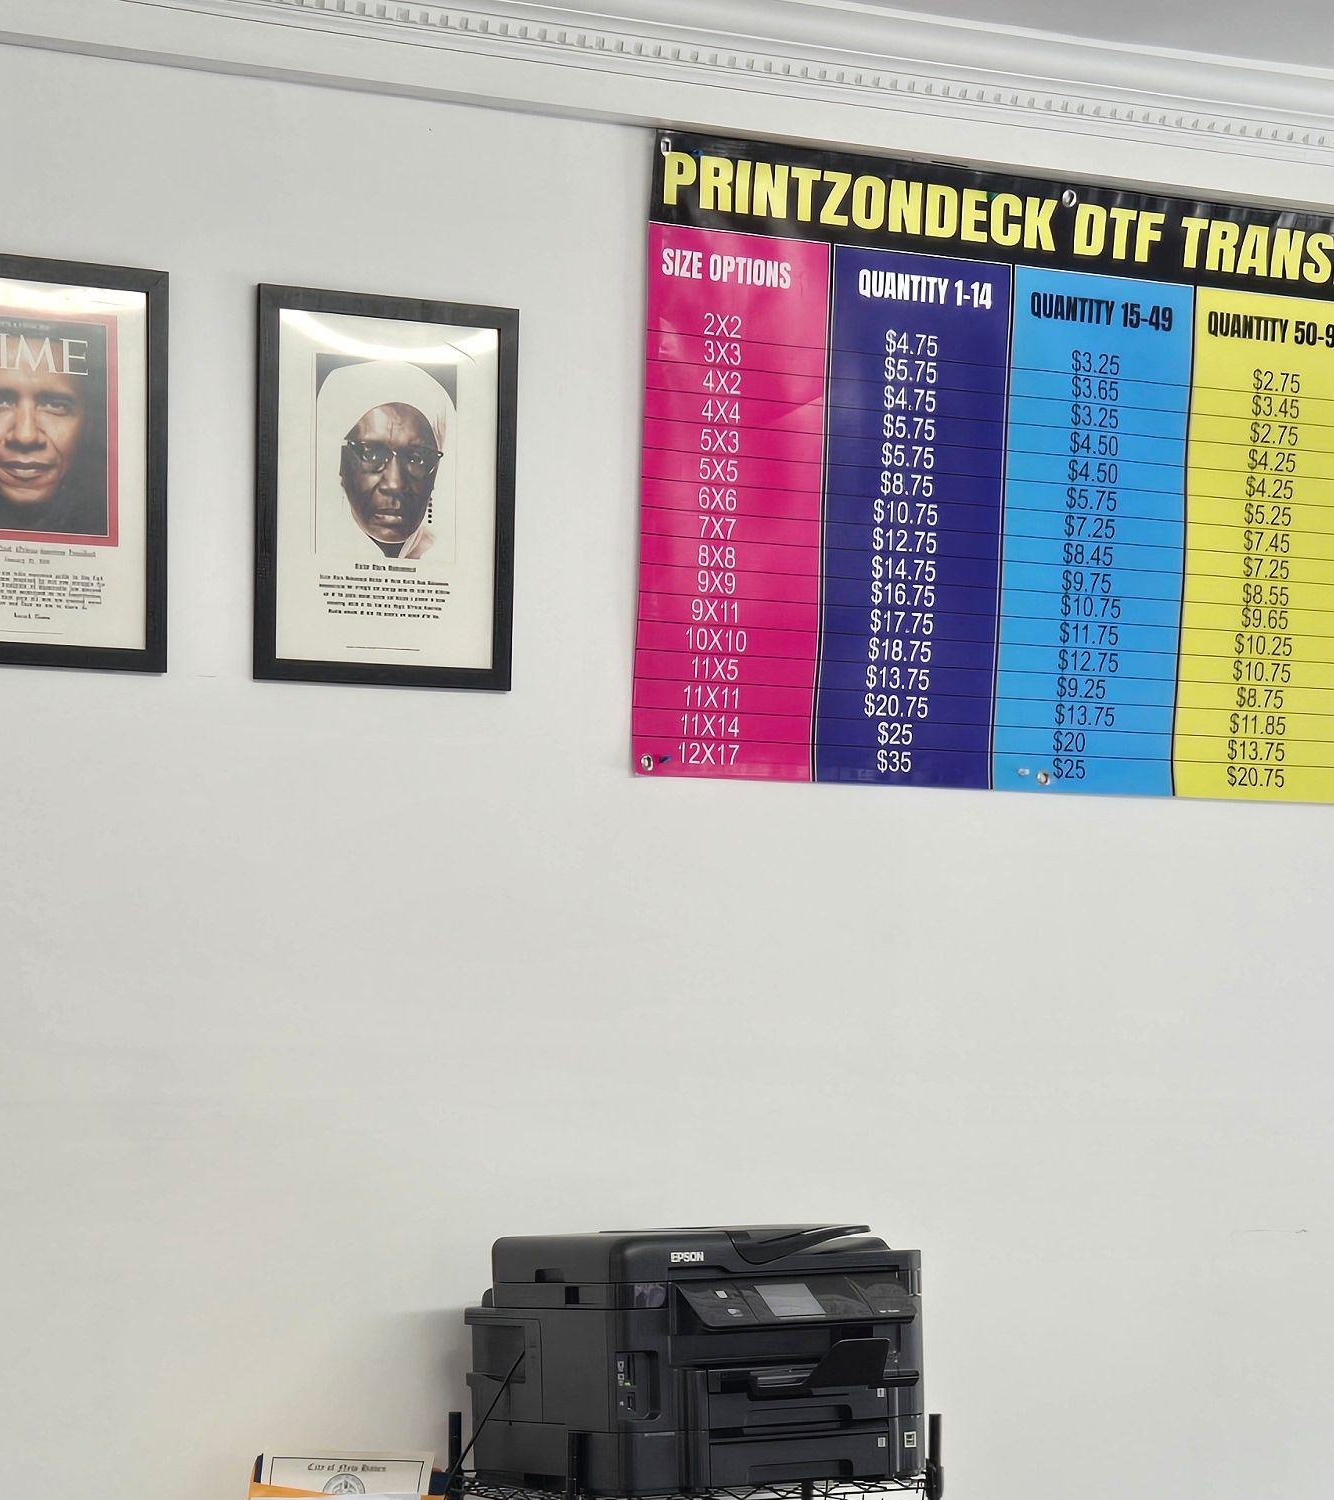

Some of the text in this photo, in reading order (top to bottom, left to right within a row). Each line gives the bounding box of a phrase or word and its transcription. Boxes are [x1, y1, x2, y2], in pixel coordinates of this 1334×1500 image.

[662, 151, 1057, 249] PRINTZONDECK
[1073, 205, 1165, 265] DTF
[661, 249, 792, 290] SIZE OPTIONS
[857, 270, 993, 310] QUANTITY 1-14
[1029, 292, 1173, 332] QUANTITY 15-49
[703, 312, 743, 339] 2X2
[1207, 312, 1289, 345] QUANTITY
[703, 341, 743, 366] 3X3
[885, 329, 939, 359] $4.75
[883, 358, 938, 386] $5.75
[1071, 349, 1121, 377] $3.25
[702, 370, 742, 395] 4X2
[1070, 376, 1120, 404] $3.65
[1252, 369, 1302, 396] $2.75
[701, 399, 741, 424] 4X4
[883, 387, 938, 414] $4.75
[1251, 395, 1301, 421] $3.45
[882, 414, 937, 442] $5.75
[1069, 402, 1119, 431] $3.25
[699, 429, 741, 454] 5X3
[1069, 431, 1119, 458] $4.50
[1249, 422, 1299, 448] $2.75
[881, 443, 936, 470] $5.75
[1248, 449, 1297, 475] $4.25
[698, 458, 739, 483] 5X5
[1068, 460, 1119, 487] $4.50
[879, 471, 935, 498] $8.75
[1246, 476, 1295, 501] $4.25
[698, 487, 739, 512] 6X6
[1066, 488, 1118, 514] $5.75
[873, 499, 938, 528] $10.75
[1244, 503, 1293, 528] $5.25
[698, 517, 738, 540] 7X7
[1065, 516, 1116, 541] $7.25
[872, 528, 938, 556] $12.75
[1243, 530, 1291, 555] $7.45
[697, 546, 737, 569] 8X8
[1063, 544, 1114, 568] $8.45
[1242, 556, 1291, 581] $7.25
[871, 556, 937, 584] $14.75
[1061, 570, 1112, 595] $9.75
[696, 571, 738, 595] 9X9
[869, 581, 936, 609] $16.75
[1060, 595, 1122, 620] $10.75
[1241, 584, 1290, 608] $8.55
[689, 598, 740, 624] 9X11
[868, 609, 935, 636] $17.75
[1241, 608, 1289, 631] $9.65
[685, 628, 748, 653] 10X10
[1059, 622, 1120, 648] $11.75
[1234, 634, 1294, 659] $10.25
[868, 638, 933, 664] $18.75
[1058, 649, 1119, 675] $12.75
[689, 657, 739, 681] 11X5
[866, 665, 931, 691] $13.75
[1233, 660, 1292, 685] $10.75
[683, 685, 742, 709] 11X11
[1056, 676, 1106, 701] $9.25
[1235, 686, 1285, 711] $8.75
[864, 693, 929, 720] $20.75
[1055, 704, 1116, 729] $13.75
[679, 713, 741, 738] 11X14
[876, 721, 914, 748] $25
[1229, 714, 1288, 738] $11.85
[678, 741, 739, 766] 12X17
[1053, 730, 1086, 754] $20
[1227, 739, 1286, 764] $13.75
[876, 749, 913, 774] $35
[1052, 756, 1086, 781] $25
[1226, 765, 1286, 790] $20.75
[670, 1251, 704, 1262] EPSON
